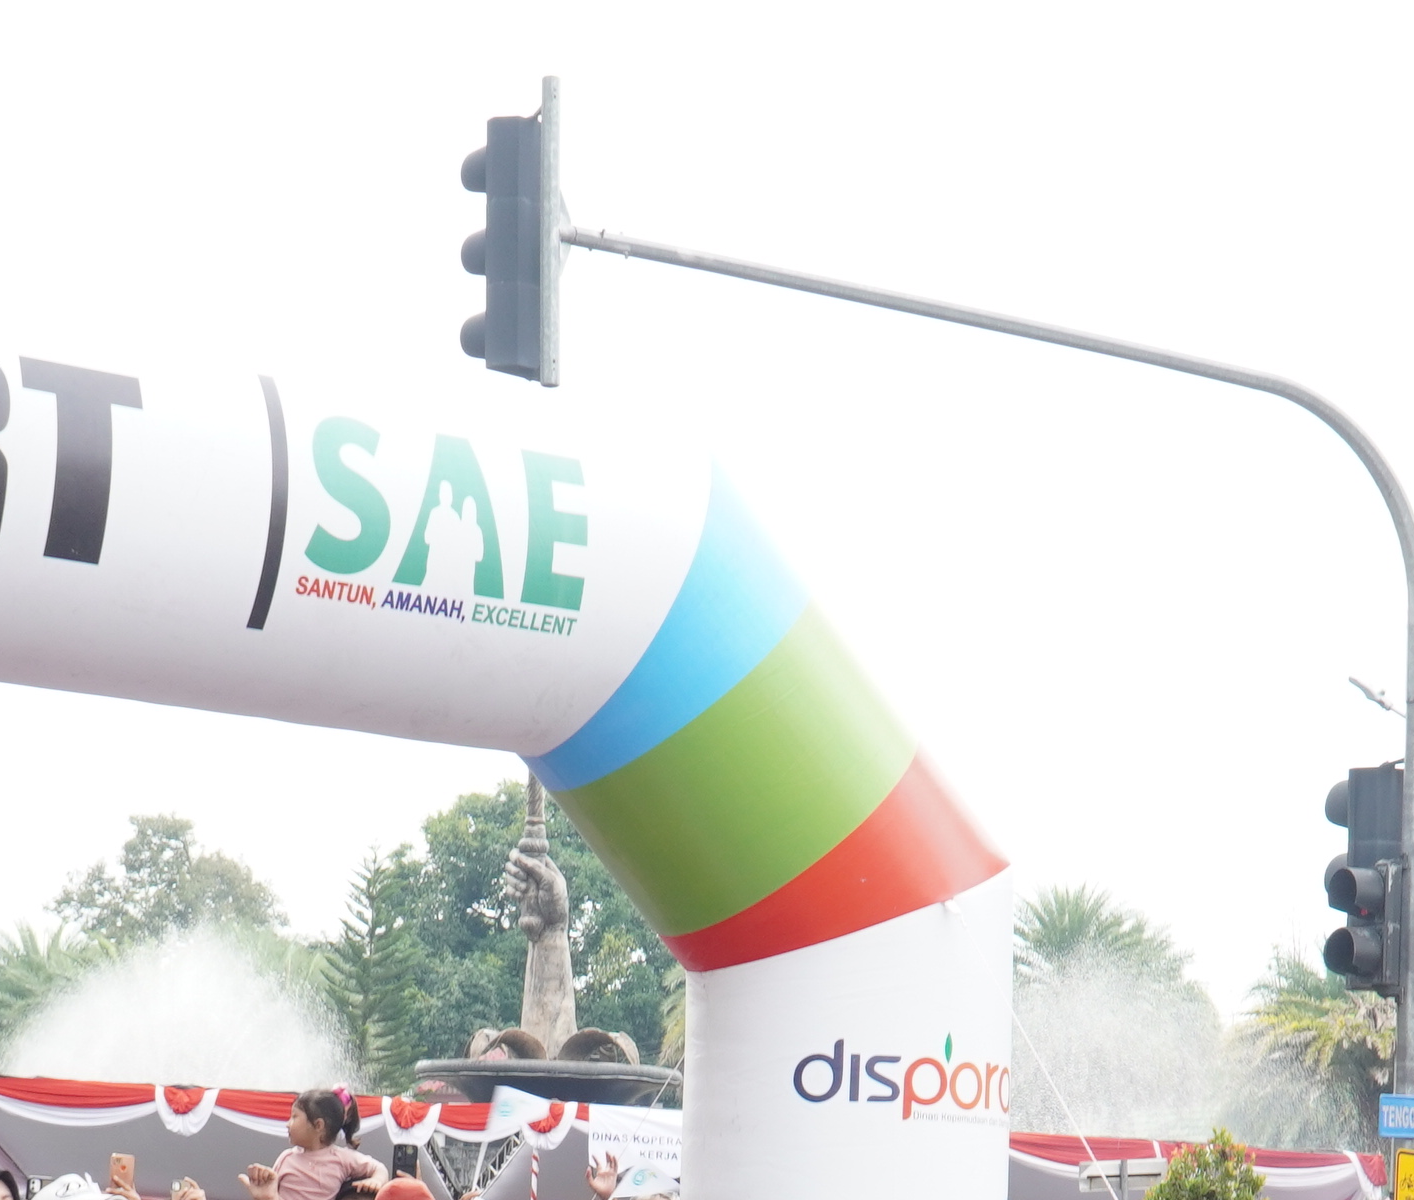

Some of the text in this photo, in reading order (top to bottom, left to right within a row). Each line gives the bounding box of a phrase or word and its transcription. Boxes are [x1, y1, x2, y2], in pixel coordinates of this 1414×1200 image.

[304, 416, 587, 611] SAE
[296, 576, 577, 636] SANTUN, AMANAH, EXCELLENT
[592, 1131, 682, 1146] DINAS KOPERA
[640, 1150, 678, 1160] KERJA
